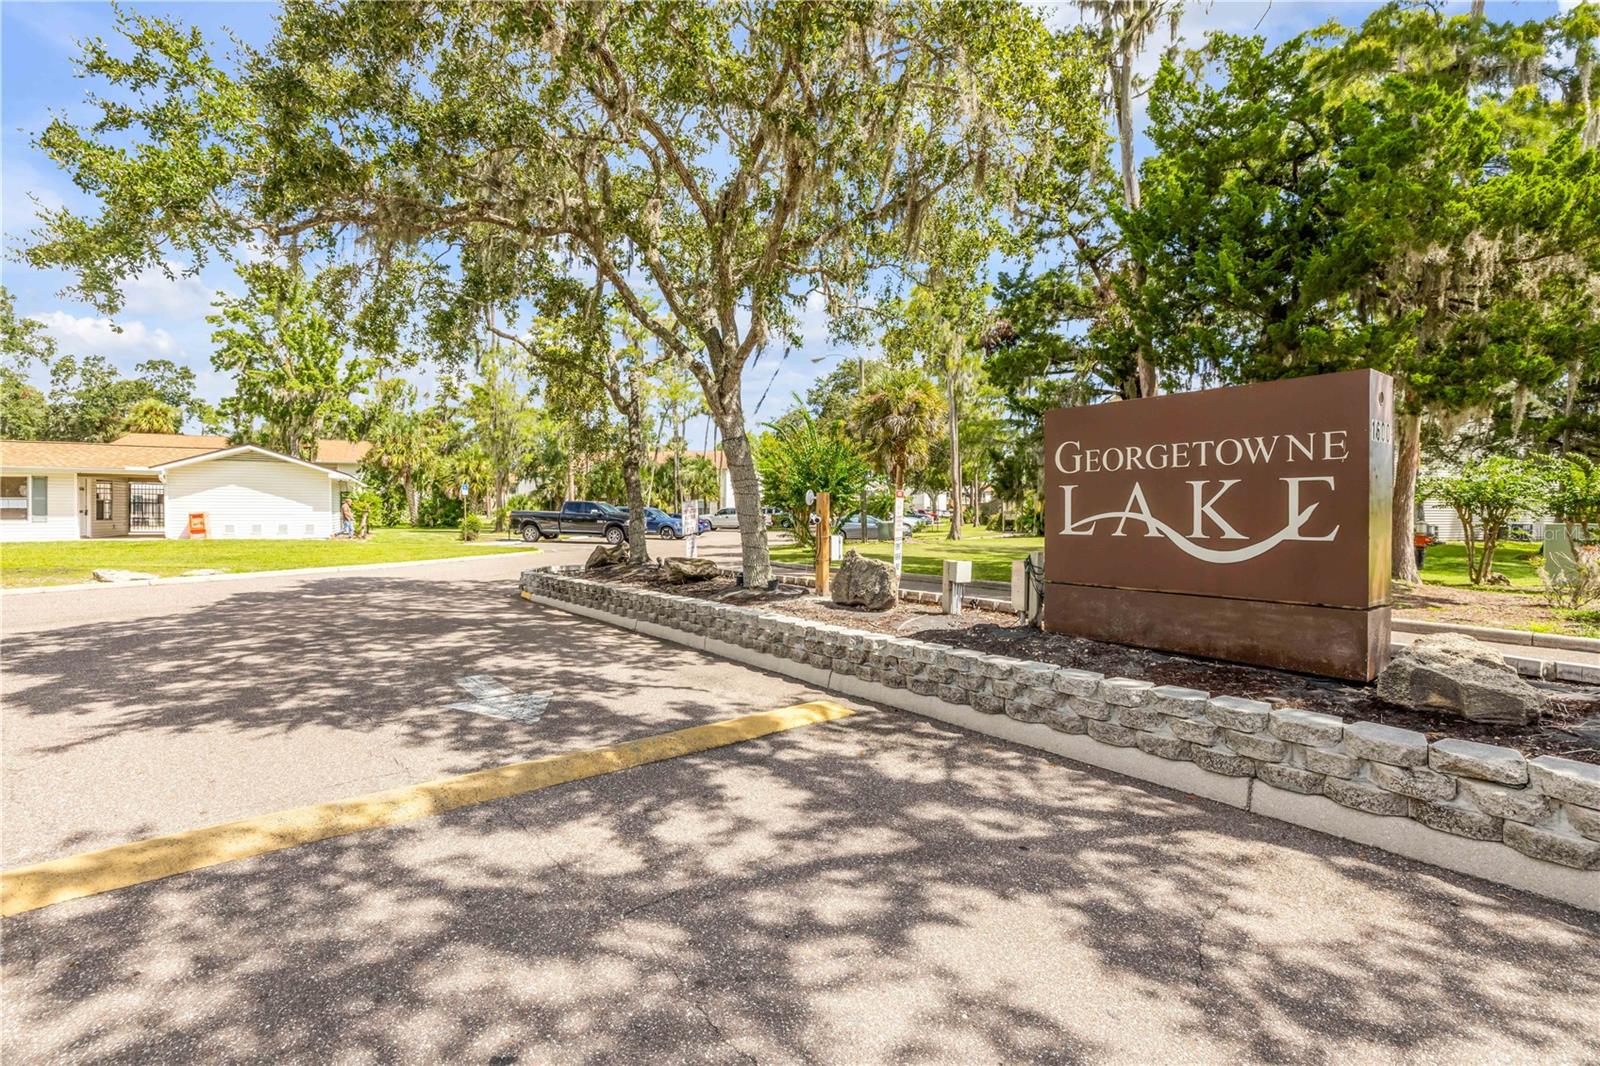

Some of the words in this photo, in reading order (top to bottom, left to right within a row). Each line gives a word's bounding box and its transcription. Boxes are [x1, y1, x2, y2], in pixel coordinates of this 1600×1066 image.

[1054, 430, 1350, 474] GEORGETOWNE
[1371, 418, 1391, 444] 1600
[1058, 476, 1340, 564] LAKE
